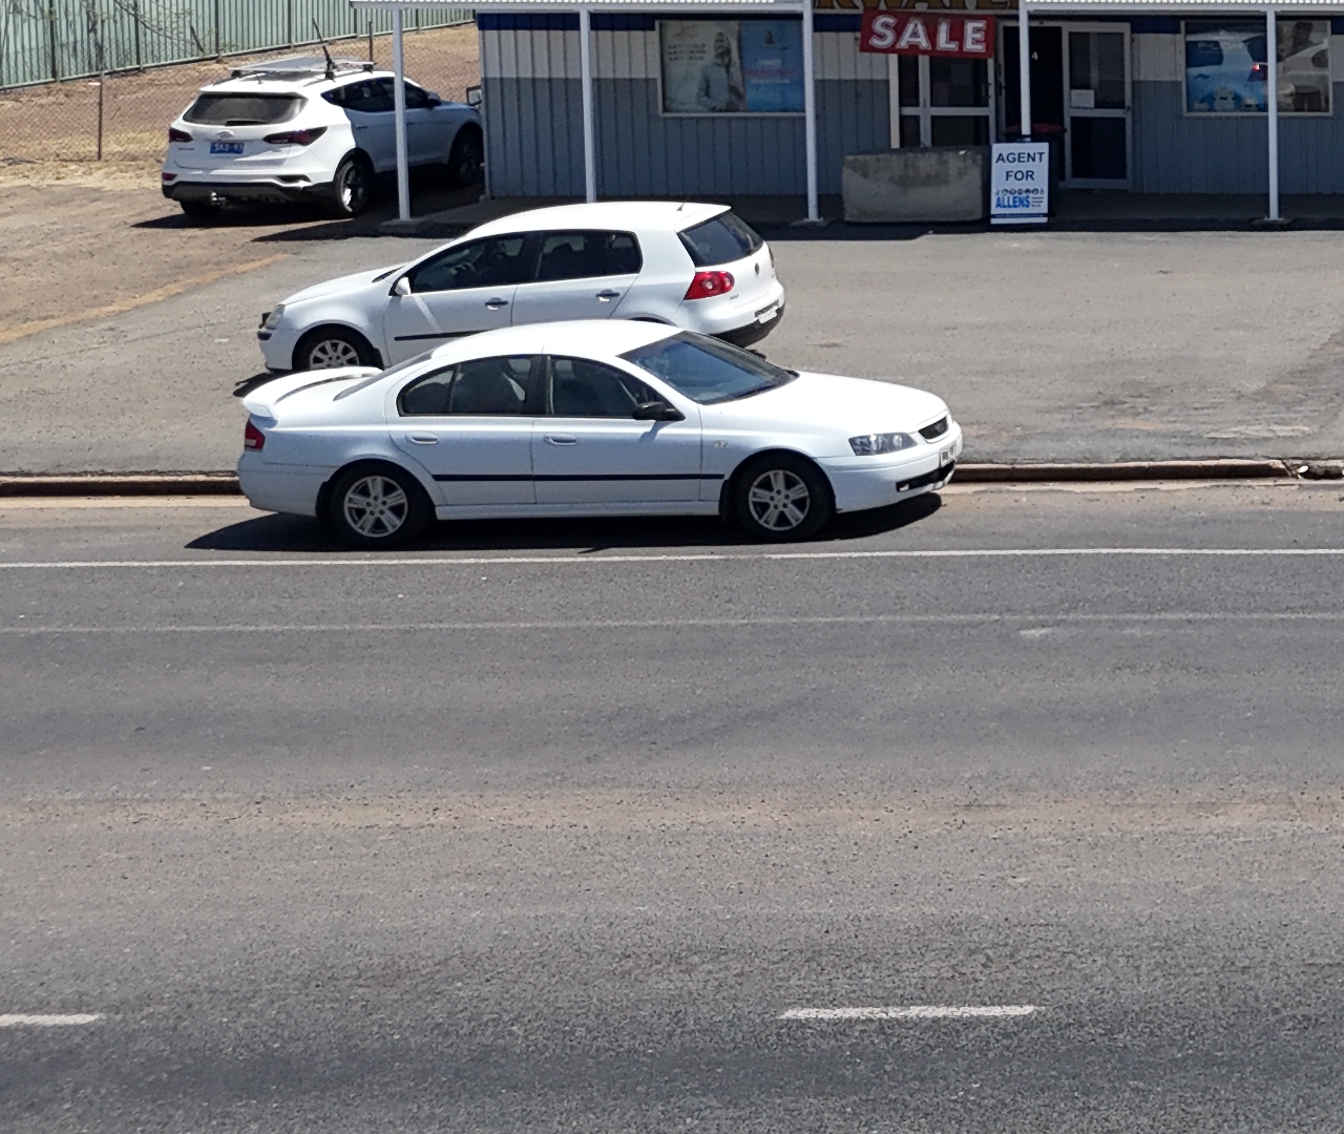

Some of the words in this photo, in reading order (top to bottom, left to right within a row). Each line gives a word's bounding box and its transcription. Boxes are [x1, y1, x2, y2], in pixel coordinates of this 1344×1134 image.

[868, 14, 988, 54] SALE
[1031, 51, 1039, 61] 4
[995, 151, 1046, 164] AGENT
[1005, 170, 1035, 182] FOR
[995, 195, 1031, 209] ALLENS
